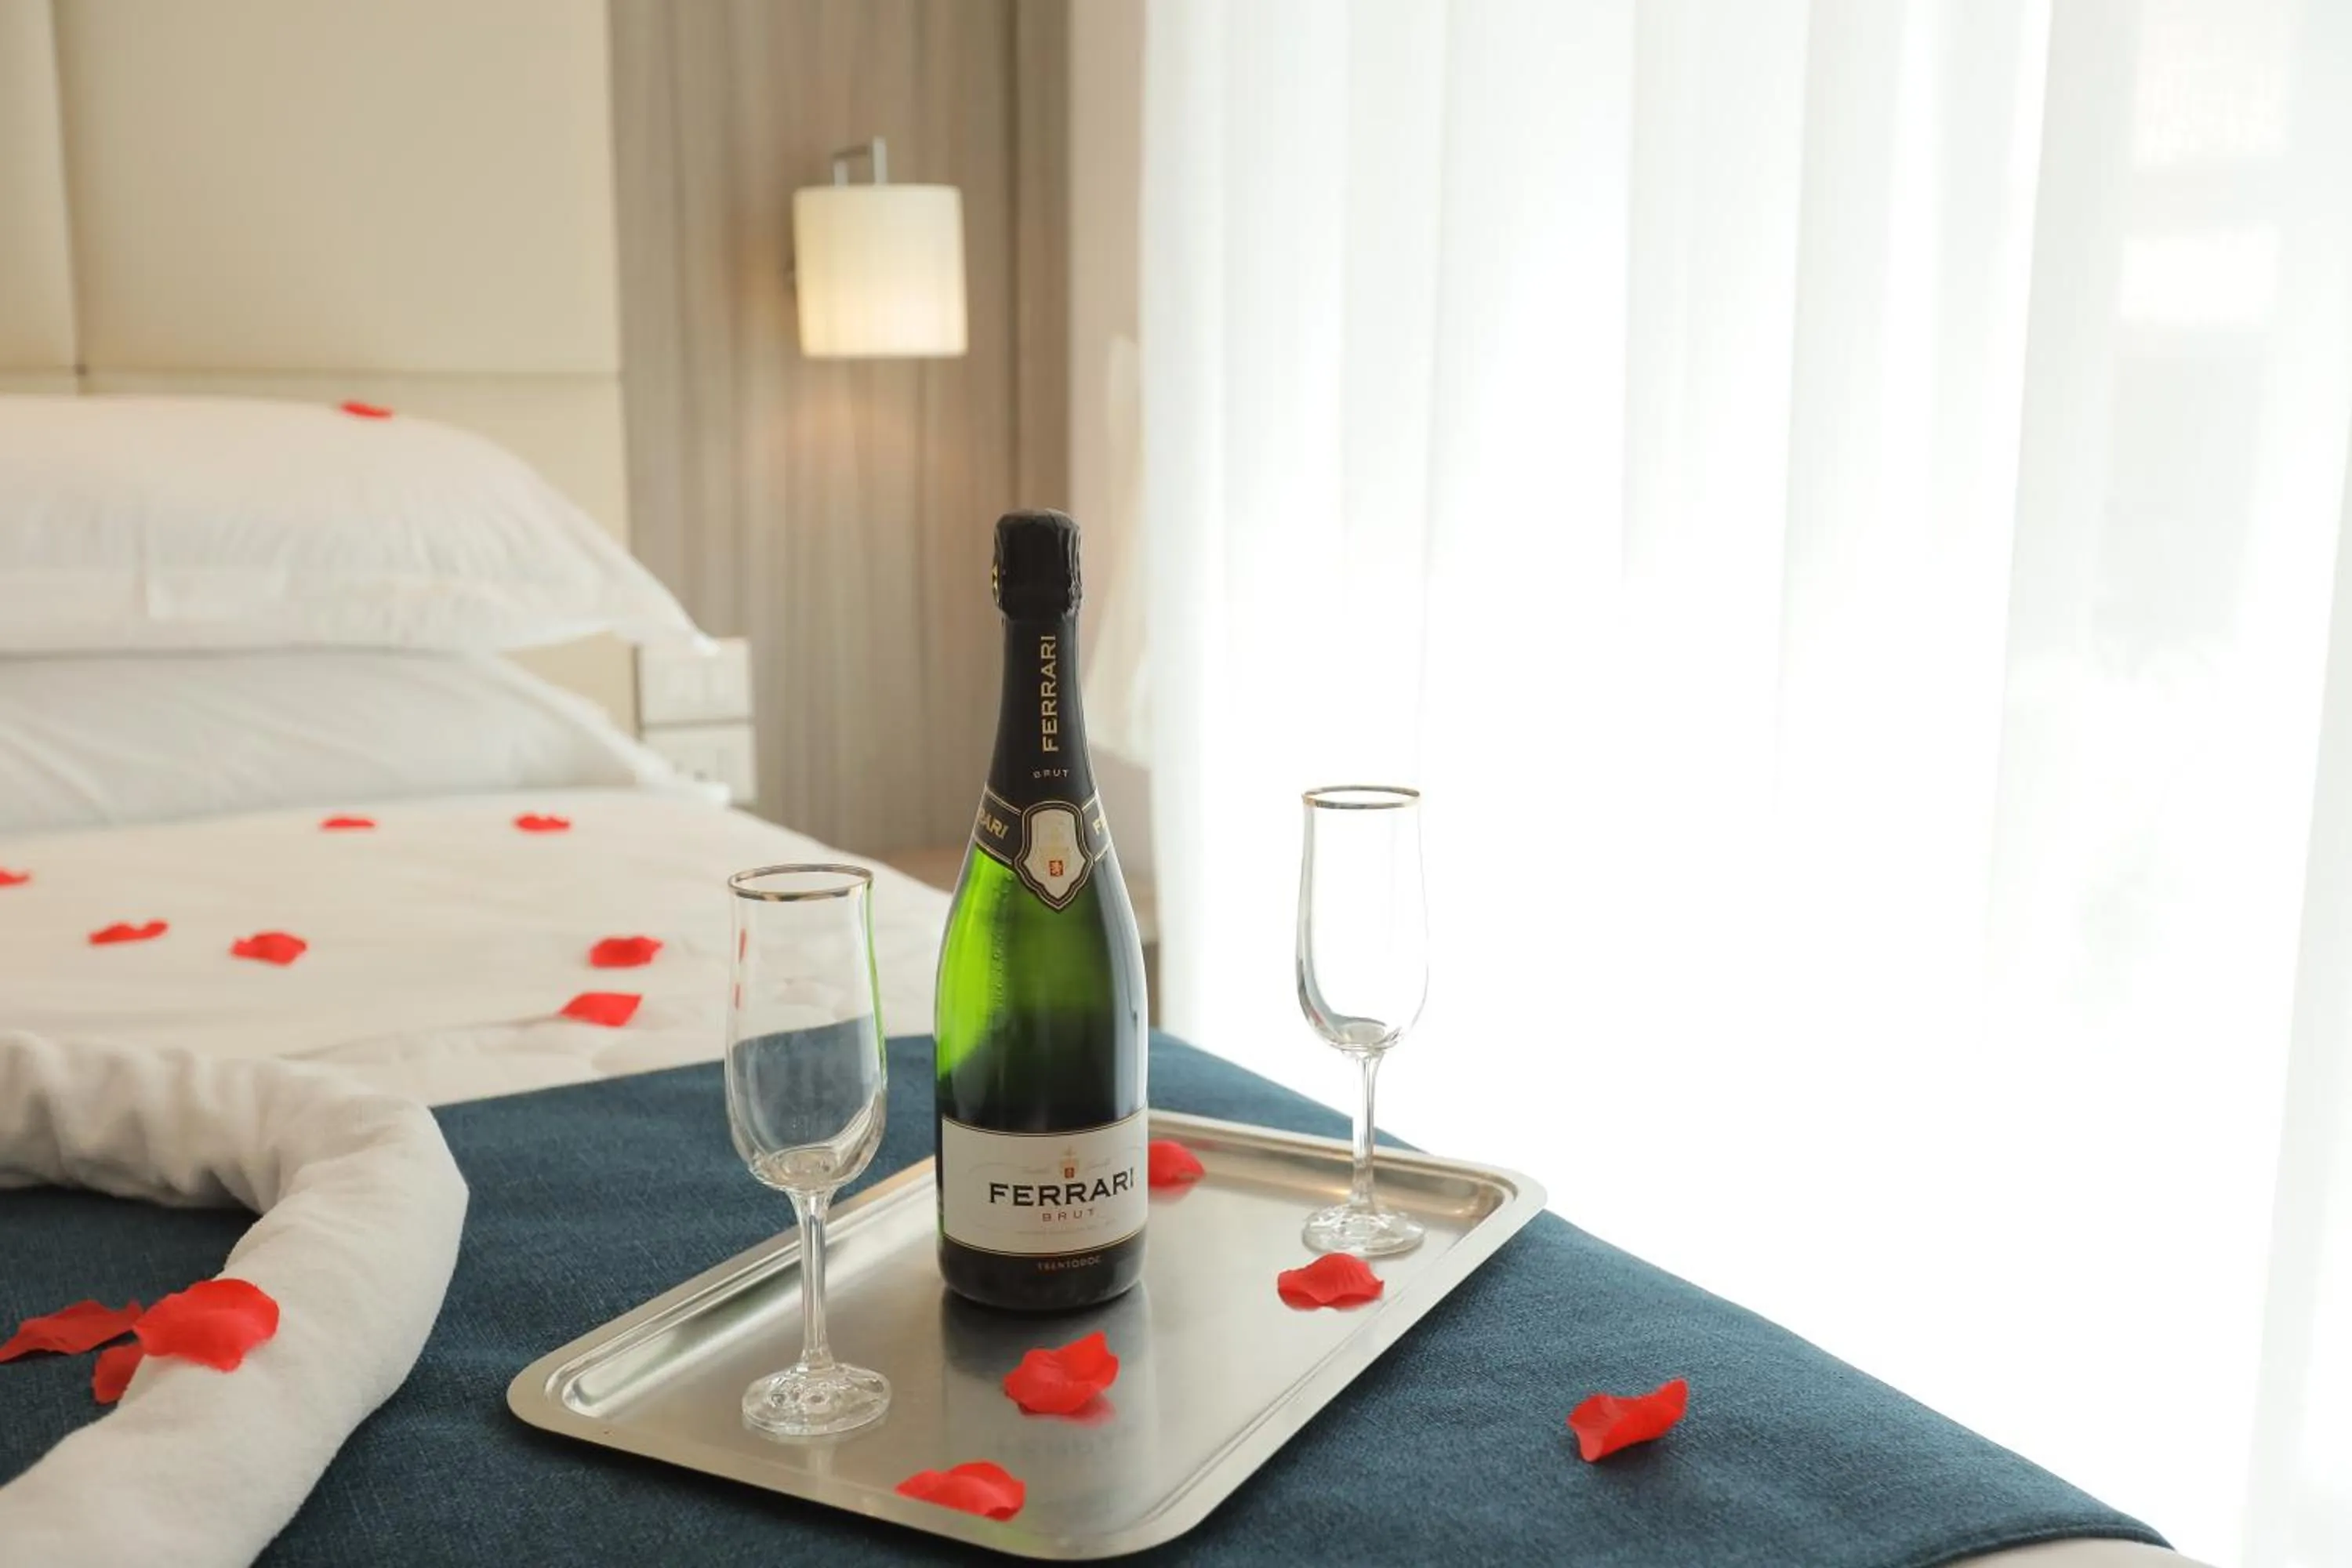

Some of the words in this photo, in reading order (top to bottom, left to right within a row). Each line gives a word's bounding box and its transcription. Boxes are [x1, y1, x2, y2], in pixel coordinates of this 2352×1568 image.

[1040, 635, 1059, 753] FERRARI
[1033, 768, 1069, 779] BRUT
[989, 1167, 1134, 1207] FERRARI
[1042, 1208, 1094, 1222] BRUT
